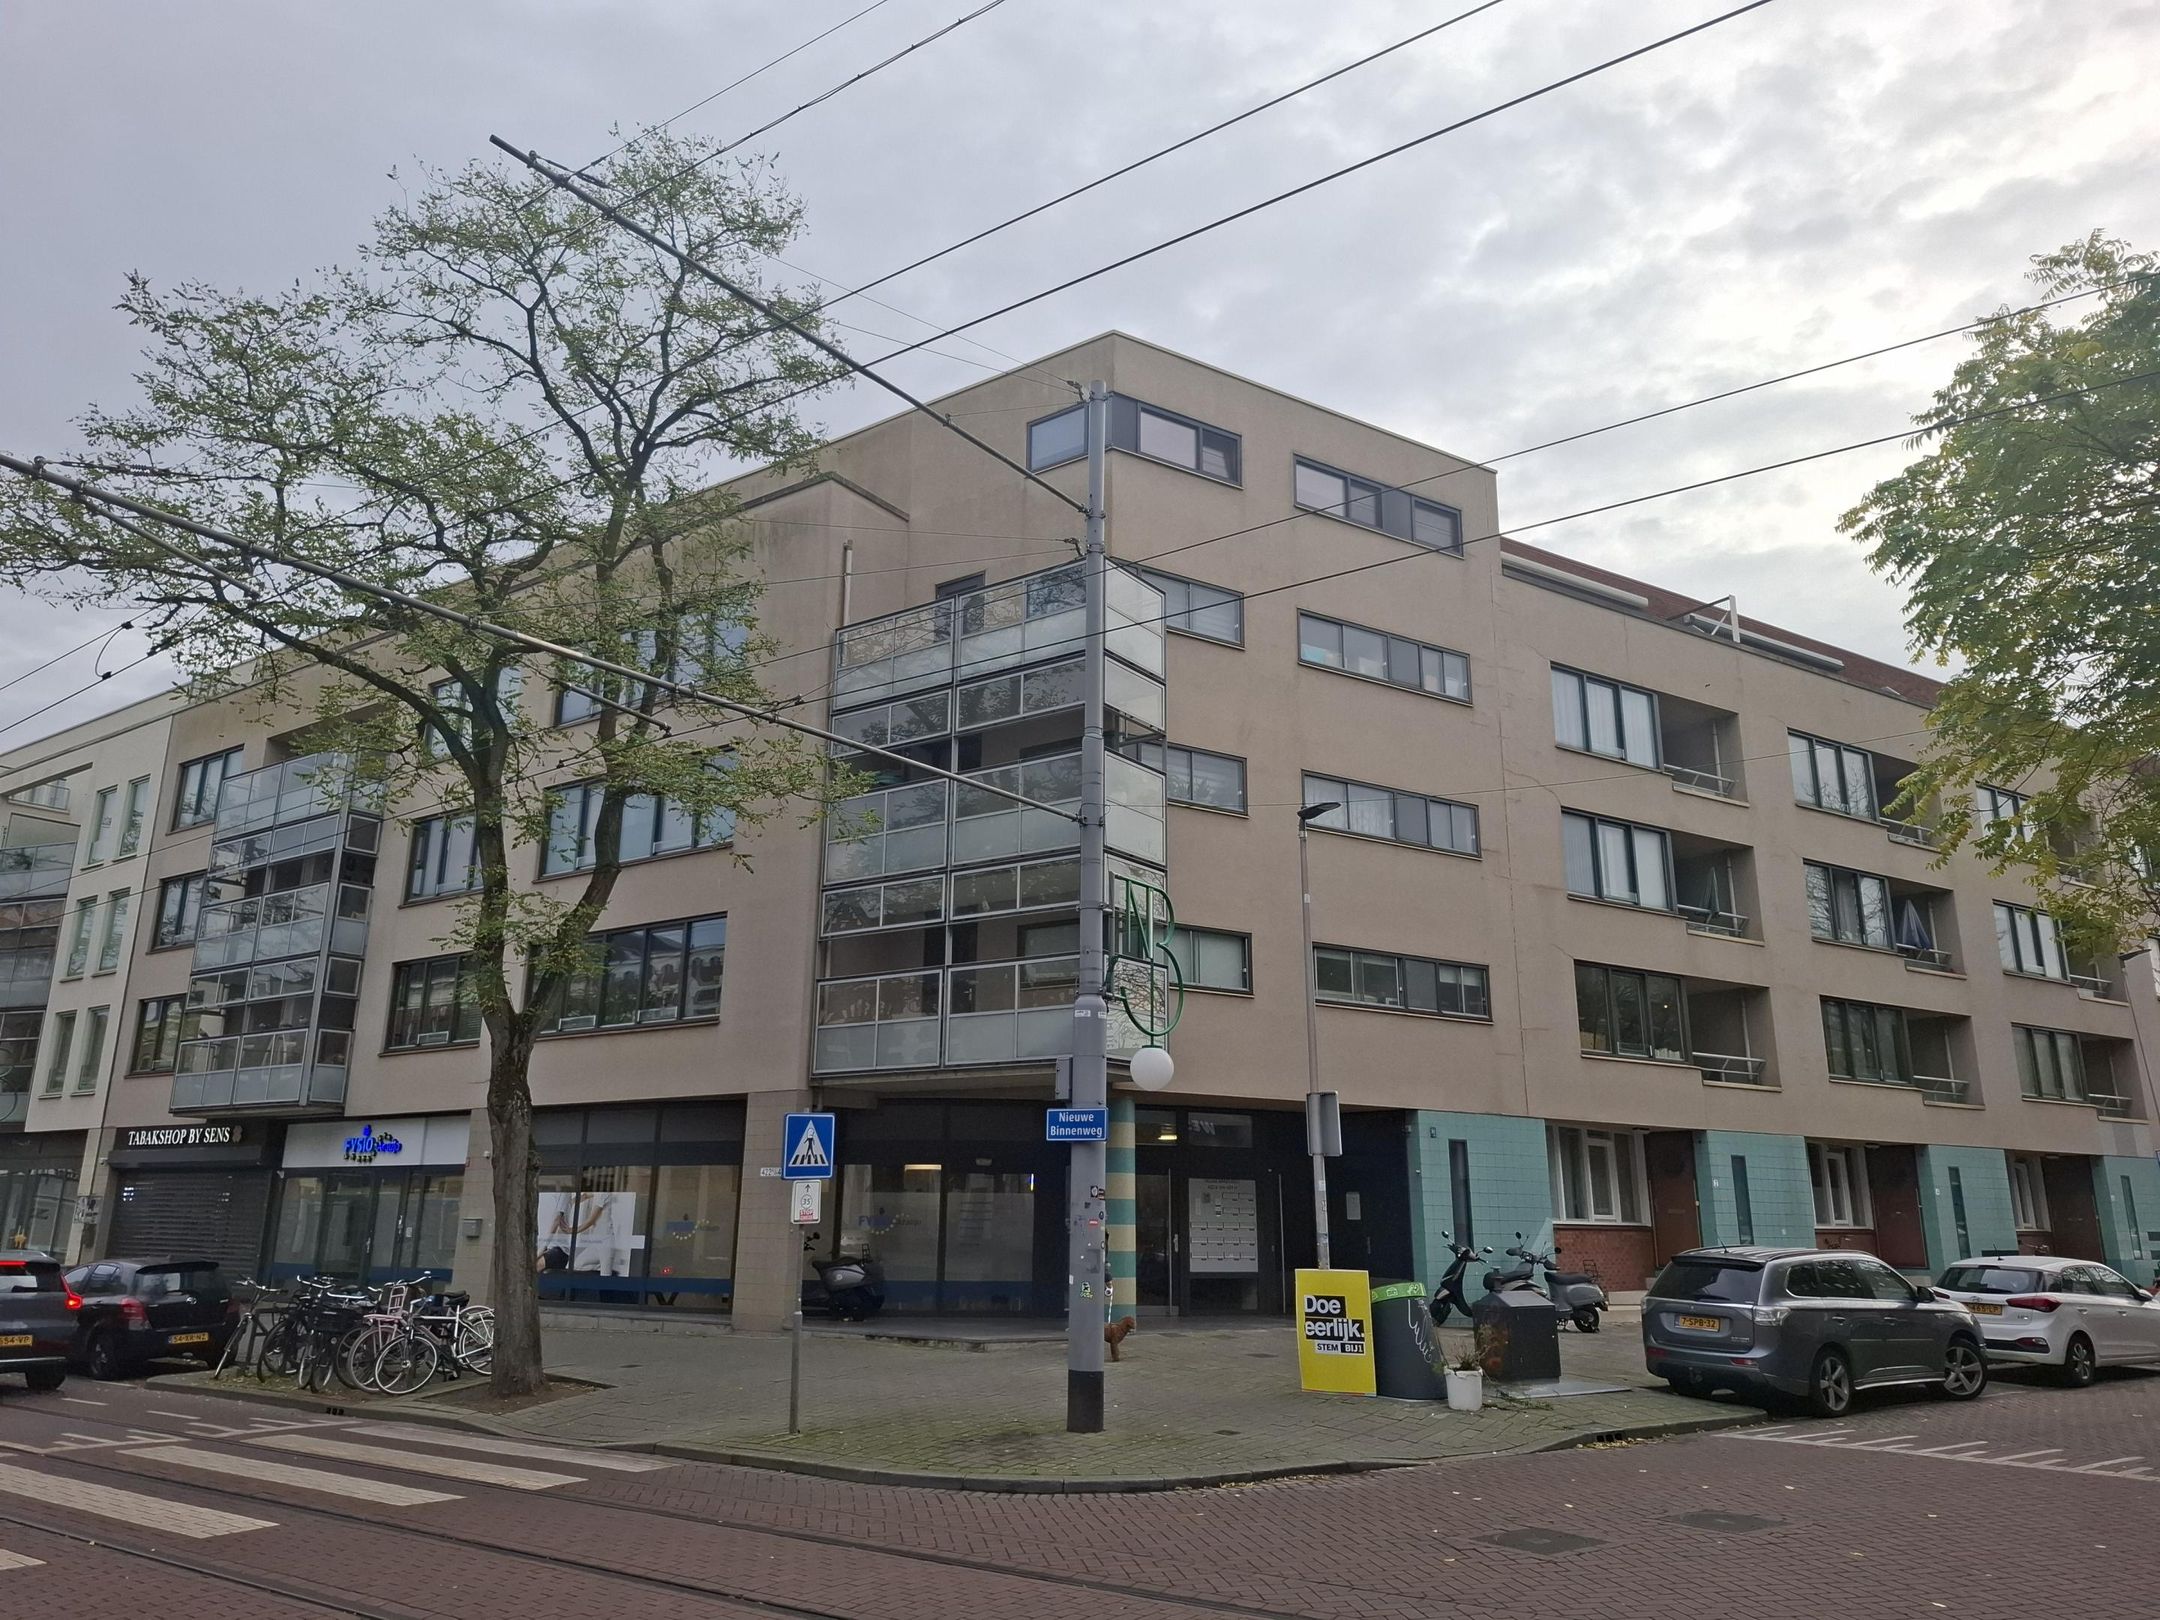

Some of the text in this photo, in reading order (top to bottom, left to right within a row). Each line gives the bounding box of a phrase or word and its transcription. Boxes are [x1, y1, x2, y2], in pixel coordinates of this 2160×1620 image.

[1058, 1112, 1094, 1122] Nieuwe
[128, 1127, 231, 1146] TABAKSHOP BY SENS
[1050, 1125, 1103, 1138] Binnenweg
[802, 1198, 811, 1206] 35
[1304, 1295, 1341, 1314] Doe
[1682, 1317, 1717, 1328] 7-SPB-32
[1305, 1319, 1365, 1342] eerlijk.
[1317, 1343, 1363, 1353] STEM BIJ1
